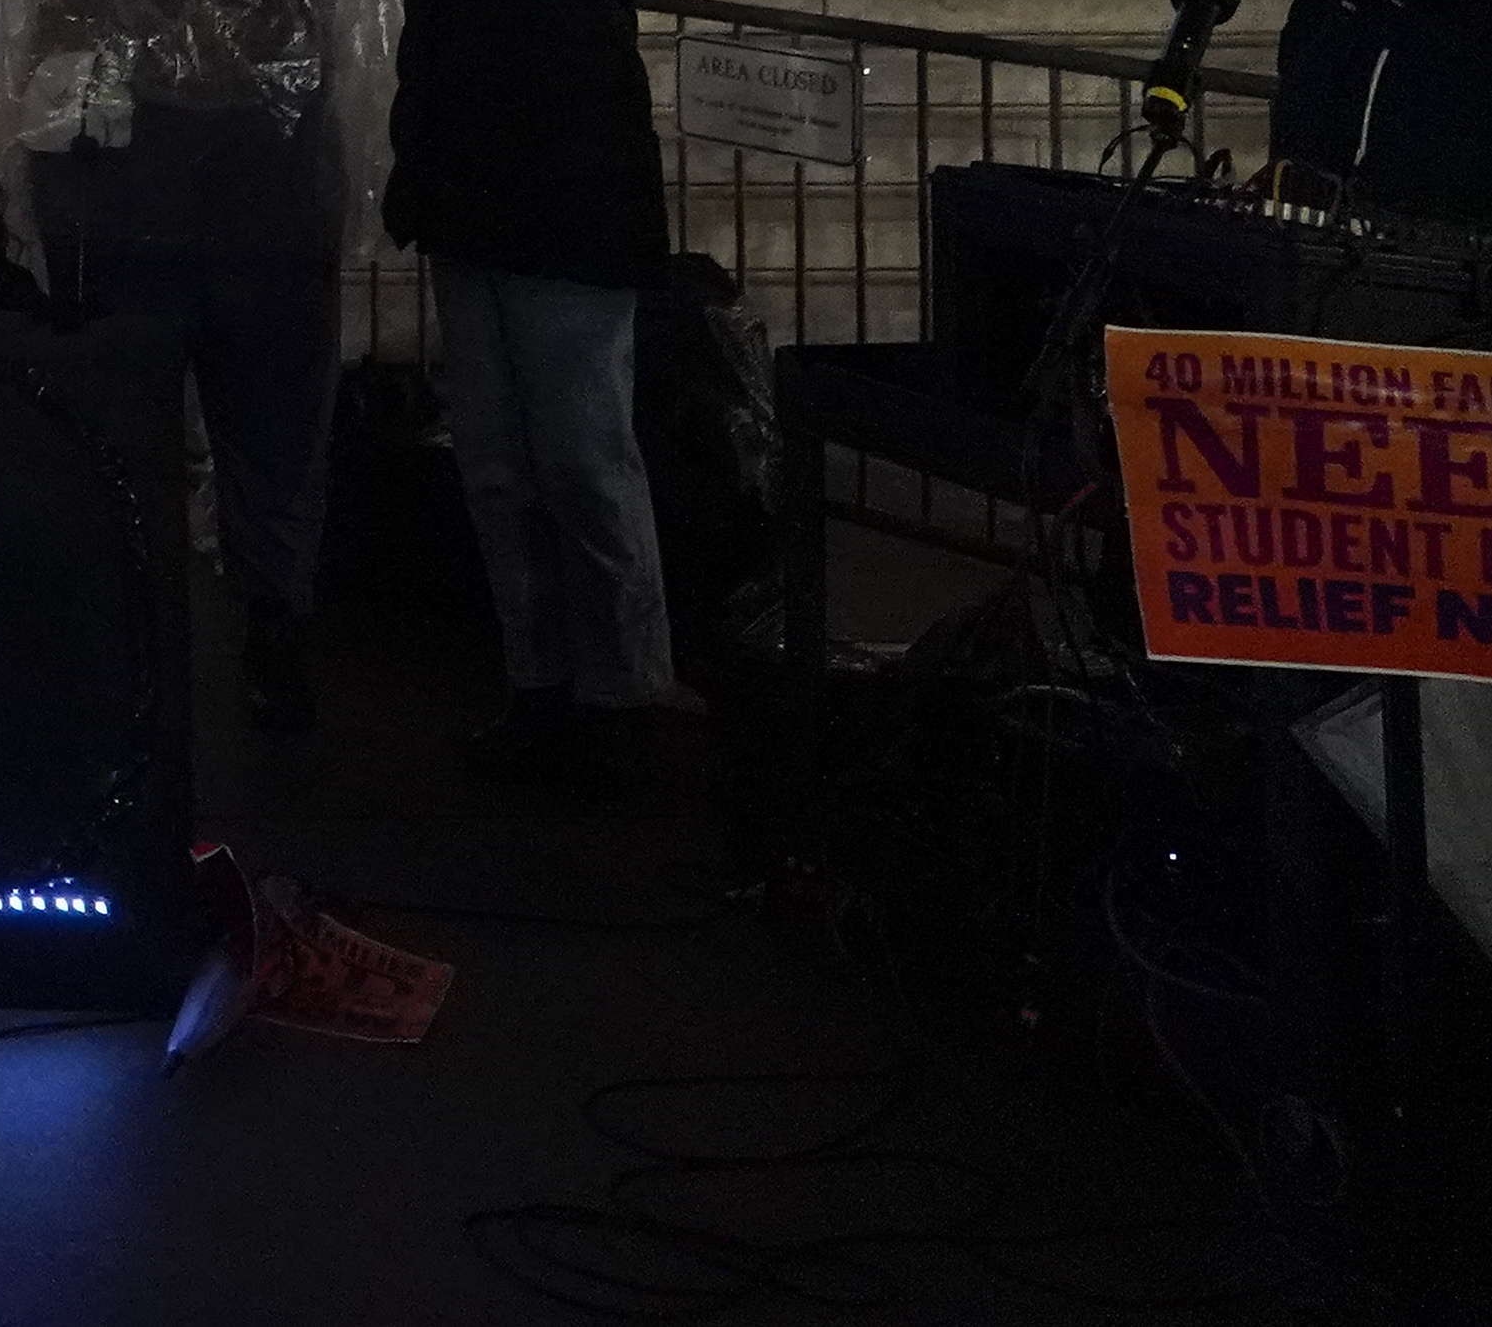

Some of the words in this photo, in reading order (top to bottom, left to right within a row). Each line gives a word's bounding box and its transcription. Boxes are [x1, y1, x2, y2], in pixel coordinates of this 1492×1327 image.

[696, 54, 749, 83] AREA
[1145, 352, 1203, 393] 40
[1222, 354, 1414, 408] MILLION
[1432, 370, 1492, 412] FA
[1161, 501, 1453, 581] STUDENT
[1167, 569, 1416, 636] RELIEF
